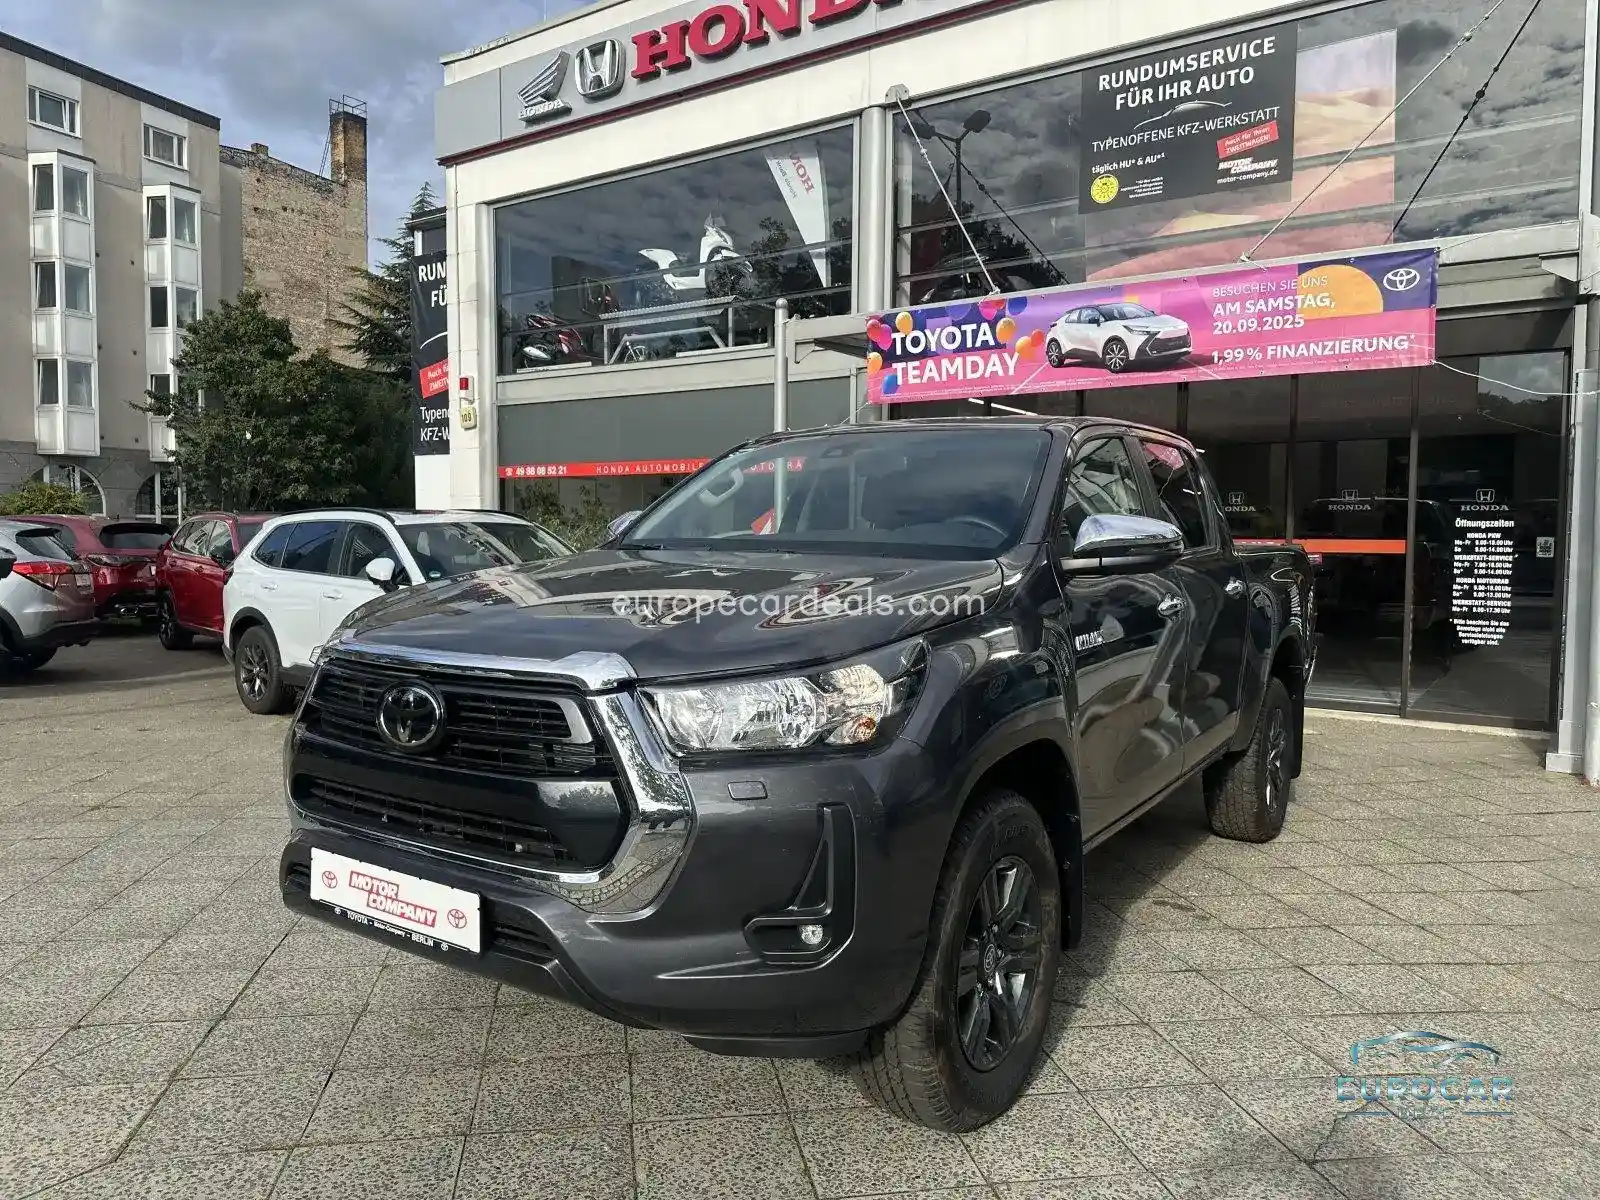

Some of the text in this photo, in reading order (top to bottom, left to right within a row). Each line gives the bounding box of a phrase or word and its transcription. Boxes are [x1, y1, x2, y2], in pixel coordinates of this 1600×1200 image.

[631, 0, 902, 78] HON
[1098, 36, 1276, 91] RUNDUMSERVICE
[1115, 66, 1254, 110] FÜR IHR AUTO
[1092, 106, 1280, 152] TYPENOFFENE KFZ-WERKSTATT
[1091, 162, 1118, 174] täglich
[1137, 157, 1143, 166] &
[1216, 169, 1279, 184] motor-company.de
[1212, 275, 1328, 298] BESUCHEN SIE UNS
[1213, 293, 1336, 317] AM SAMSTAG,
[892, 322, 995, 355] TOYOTA
[1212, 314, 1305, 335] 20.09.2025
[892, 352, 1019, 385] TEAMDAY
[1211, 349, 1244, 365] 1,99
[1247, 347, 1262, 361] %
[596, 465, 630, 475] HONDA
[1455, 518, 1514, 529] Öffnungszeiten
[350, 870, 399, 899] MOTOR
[368, 893, 437, 928] COMPANY
[346, 910, 369, 926] TOYOTA
[411, 932, 434, 947] BERLIN
